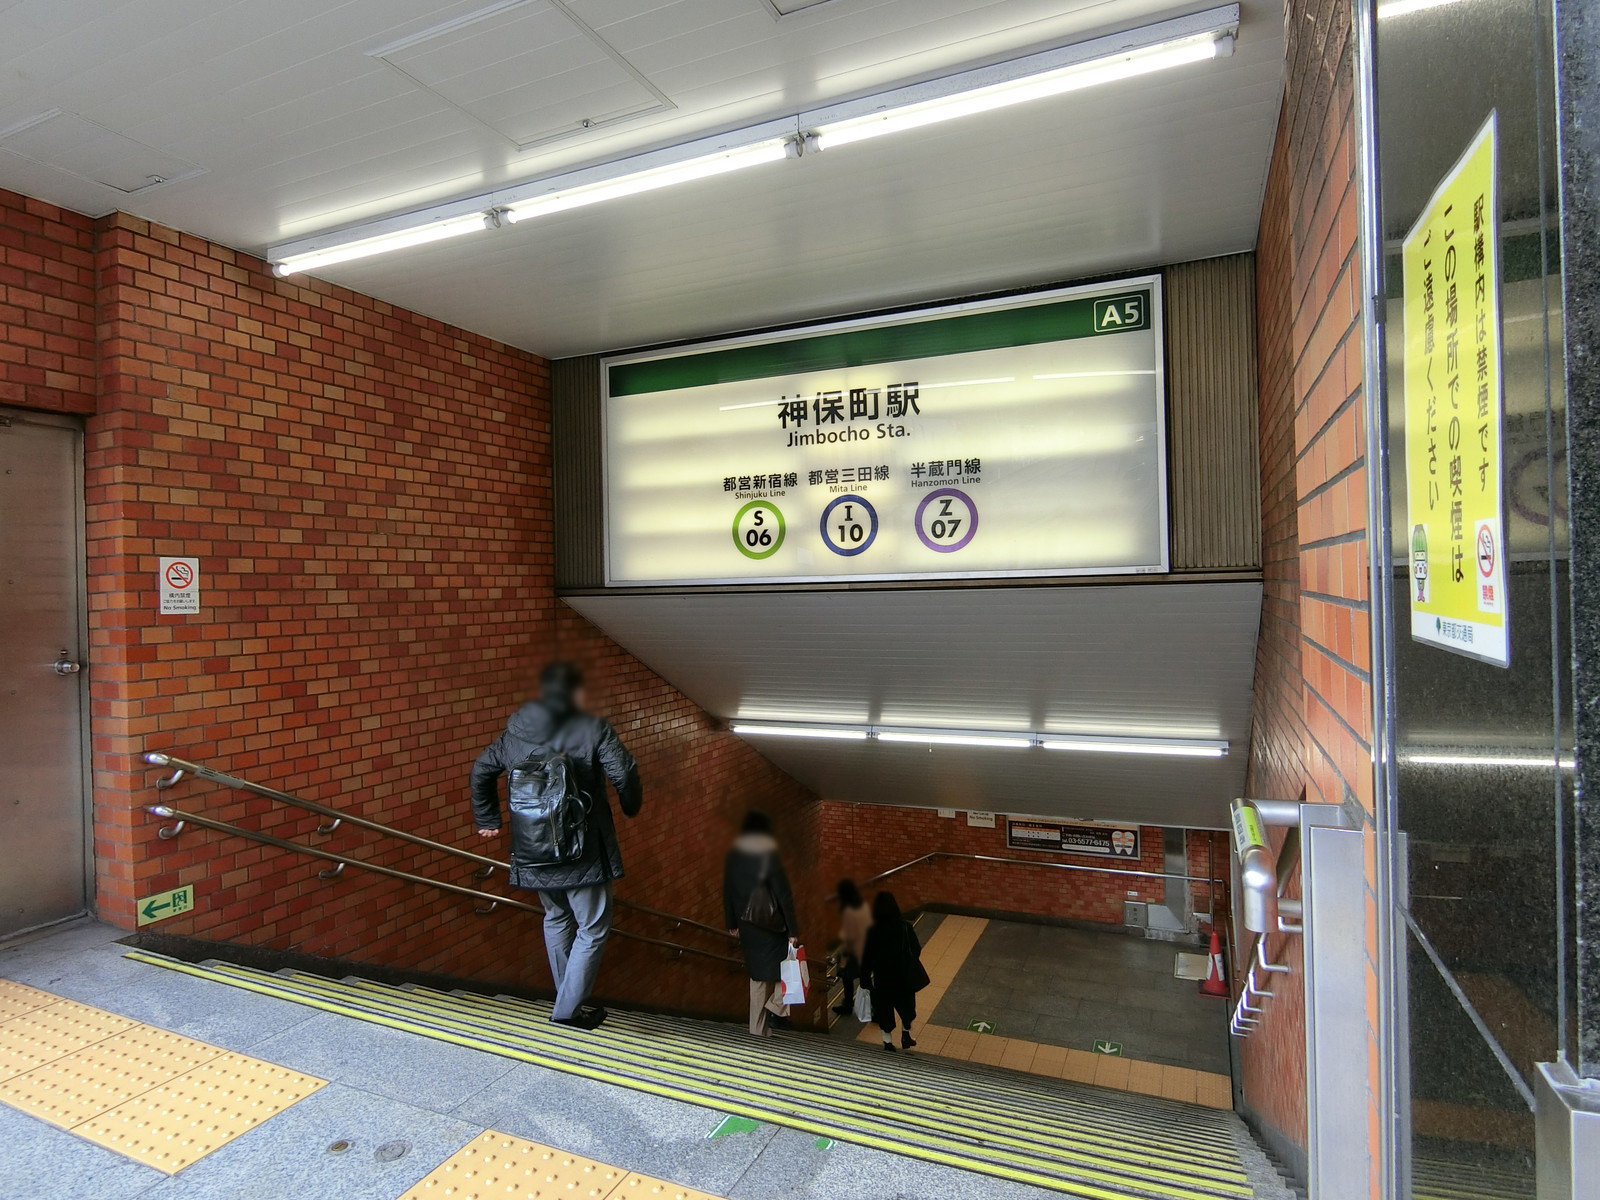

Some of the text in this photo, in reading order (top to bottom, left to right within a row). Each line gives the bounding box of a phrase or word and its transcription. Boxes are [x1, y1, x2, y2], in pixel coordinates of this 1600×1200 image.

[1101, 301, 1139, 327] A5
[1473, 193, 1489, 492] 駅構内は禁煙です
[1423, 229, 1439, 511] ご遠慮ください
[1444, 203, 1464, 583] この場所での喫煙は
[777, 381, 921, 429] 神保町駅
[786, 423, 911, 447] Jimbocho Sta.
[808, 465, 890, 486] 都営三田線
[910, 457, 982, 479] 半蔵門線
[723, 472, 798, 492] 都営新宿線
[829, 483, 868, 493] Mita Line
[911, 475, 981, 488] Hanzomon Line
[735, 489, 786, 500] Shinjuku Line
[844, 505, 853, 521] I
[939, 499, 953, 516] Z
[753, 510, 764, 526] S
[746, 528, 772, 547] 06
[838, 524, 864, 542] 10
[931, 519, 962, 539] 07
[1442, 621, 1473, 644] 東京都交通局
